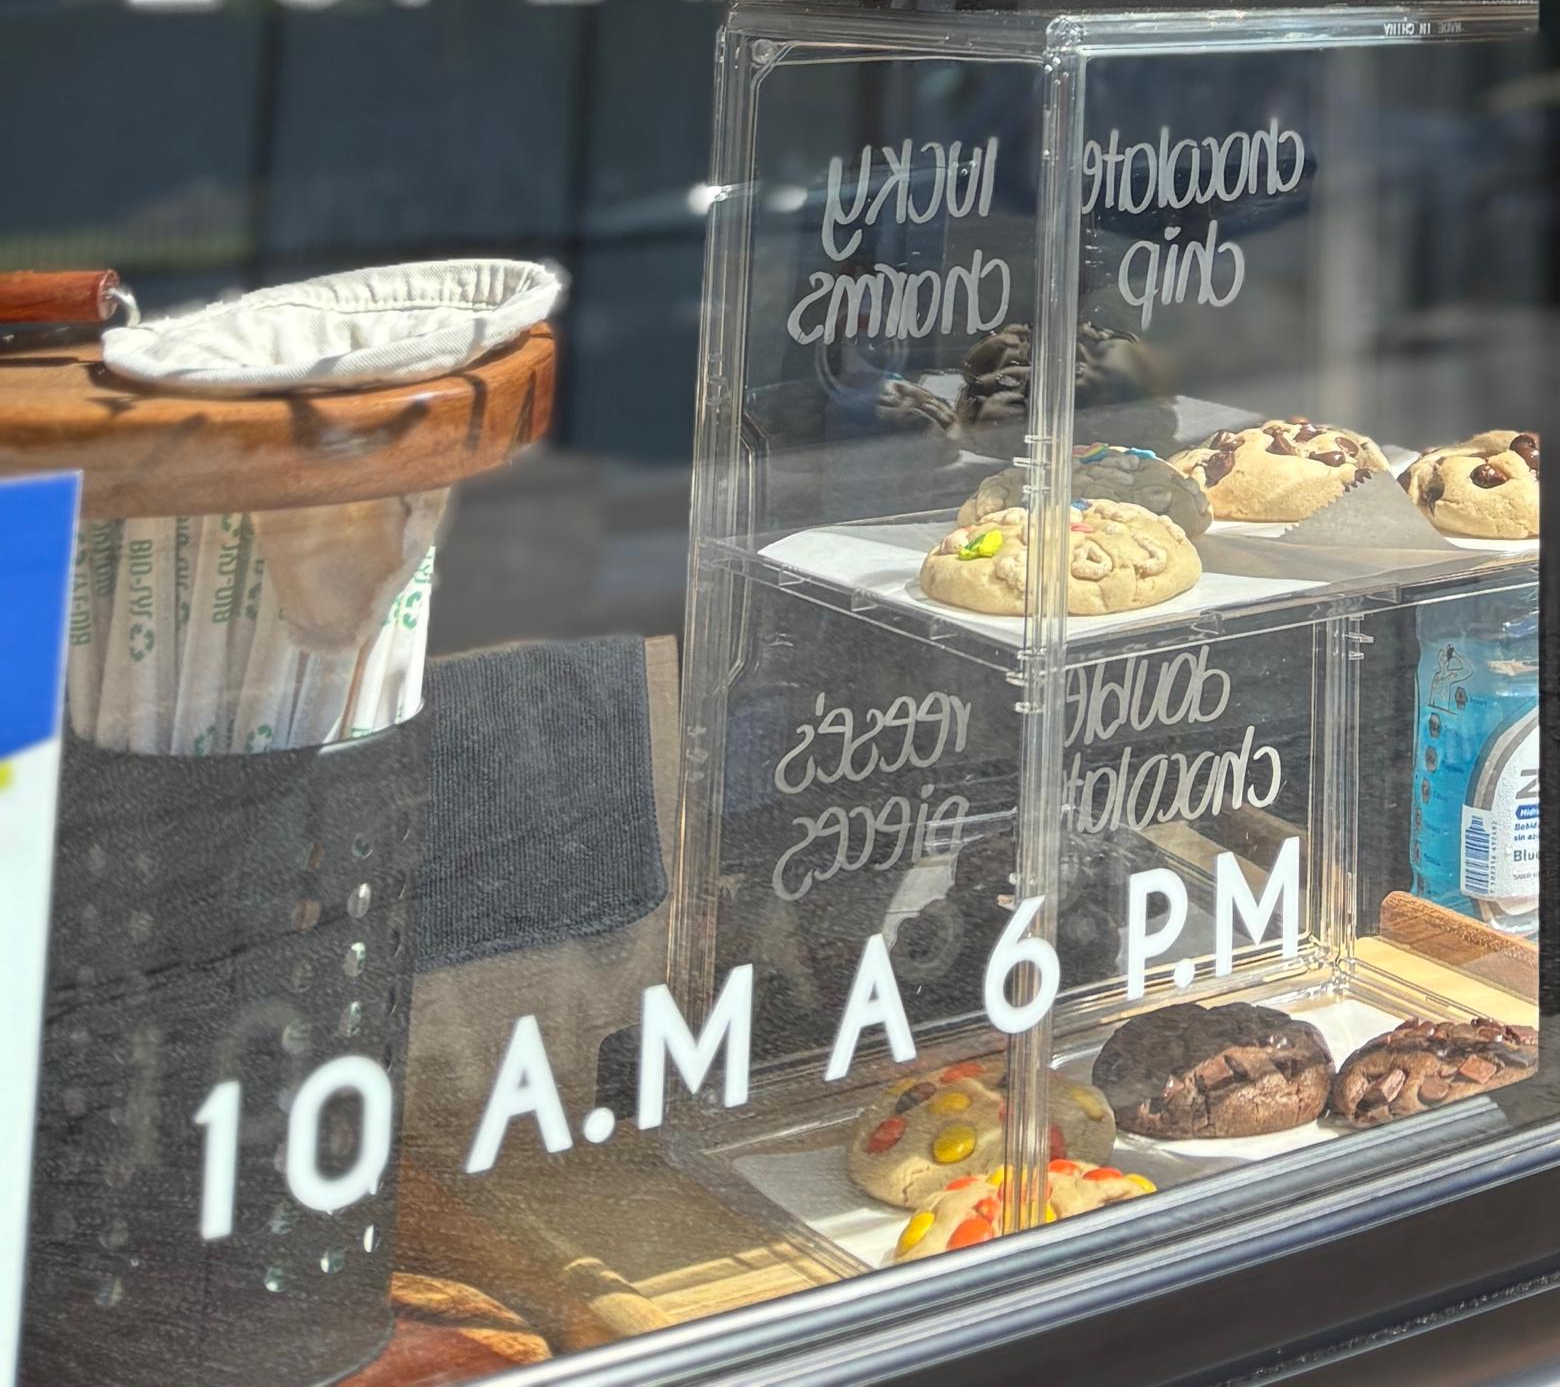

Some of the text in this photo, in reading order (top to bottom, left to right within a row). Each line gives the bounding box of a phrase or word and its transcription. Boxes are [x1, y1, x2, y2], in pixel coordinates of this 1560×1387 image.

[193, 836, 1301, 1241] 10 A.M A 6 P.M
